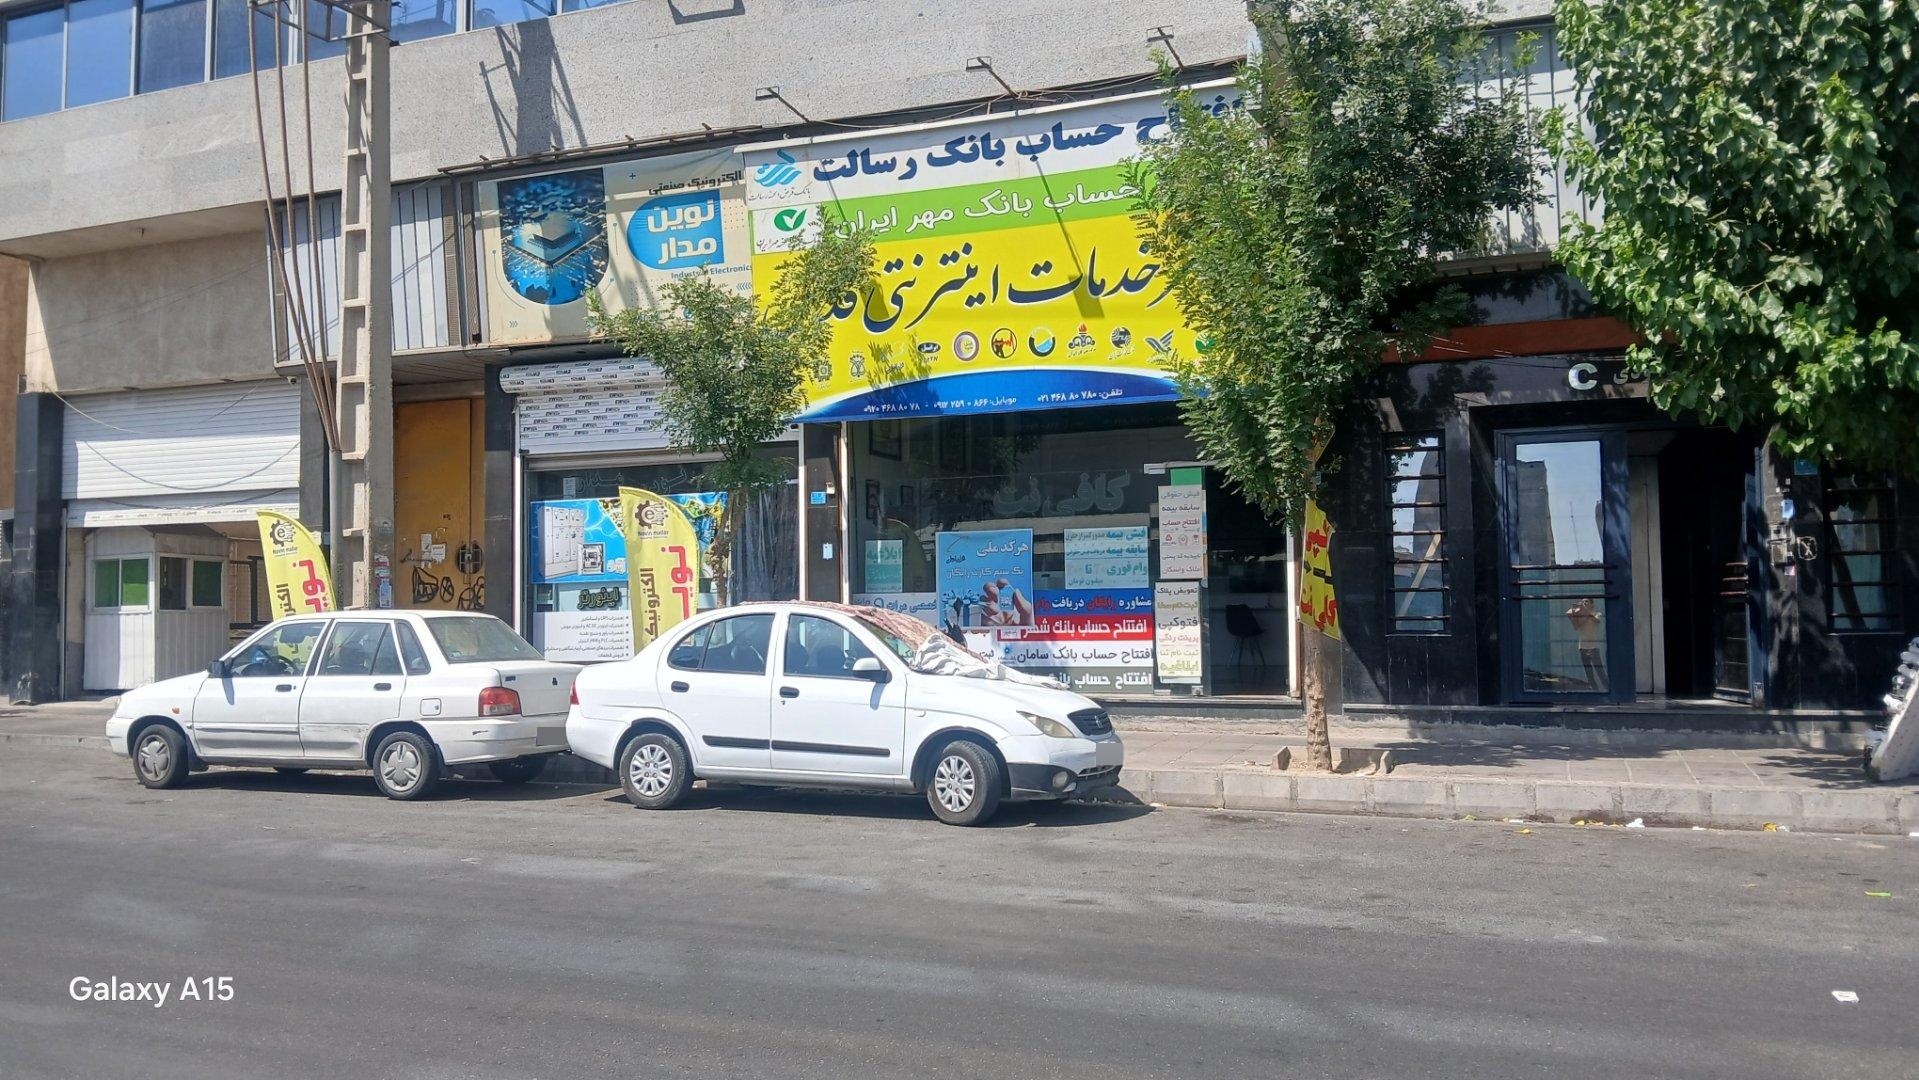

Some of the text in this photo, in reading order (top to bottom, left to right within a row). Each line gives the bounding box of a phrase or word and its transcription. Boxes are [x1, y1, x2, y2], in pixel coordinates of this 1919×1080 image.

[927, 131, 1006, 167] بانک
[1016, 121, 1125, 162] حساب
[813, 147, 918, 182] رسالت
[649, 170, 742, 196] الکترونیک صنعتی
[647, 198, 715, 234] نوین
[834, 182, 1141, 240] حساب بانک مهر ایران
[658, 236, 717, 265] مدار
[1006, 243, 1163, 306] خدمات
[861, 241, 1000, 334] اینترنتی
[1568, 362, 1598, 391] C
[976, 540, 999, 557] ملی
[660, 545, 694, 621] نوی
[1051, 594, 1085, 611] دریافت
[1118, 594, 1152, 610] مشاوره
[1077, 618, 1111, 638] حساب
[1113, 618, 1147, 639] افتتاح
[1159, 616, 1198, 631] فتوکپی
[1017, 648, 1049, 664] سامان
[1052, 646, 1078, 663] بانک
[1081, 648, 1118, 664] حساب
[1121, 648, 1154, 664] افتتاح
[1075, 671, 1111, 689] حساب
[1115, 671, 1153, 690] افتتاح
